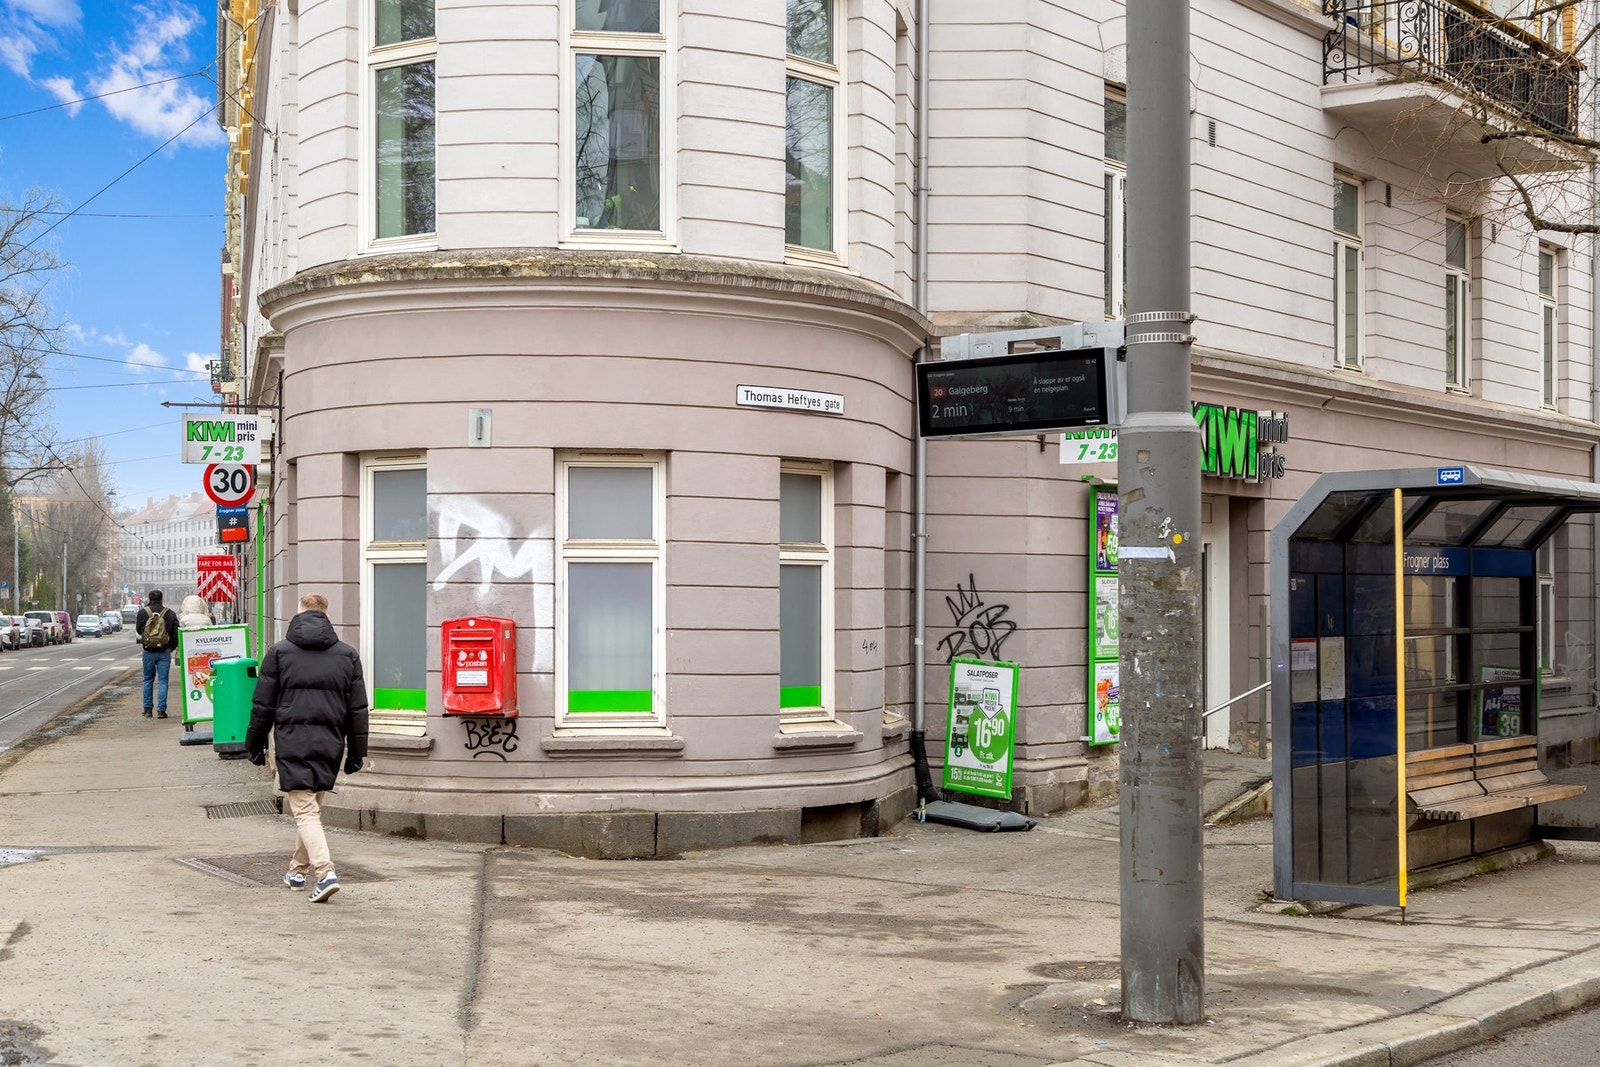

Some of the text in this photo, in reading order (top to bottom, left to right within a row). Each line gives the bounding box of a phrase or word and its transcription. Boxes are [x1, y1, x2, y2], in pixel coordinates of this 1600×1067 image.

[948, 385, 988, 397] Galgeberg
[744, 390, 840, 410] Thomas Heftyes gate
[932, 403, 967, 418] 2 min
[187, 420, 236, 442] KIWI
[237, 421, 258, 431] mini
[1258, 410, 1289, 443] mini
[237, 431, 256, 443] pris
[1257, 446, 1286, 483] pris
[213, 469, 247, 494] 30
[1404, 552, 1450, 573] Frogner plass
[196, 636, 232, 644] KYLLINGFILET
[465, 660, 488, 668] posten
[967, 669, 999, 679] SALATPOSER
